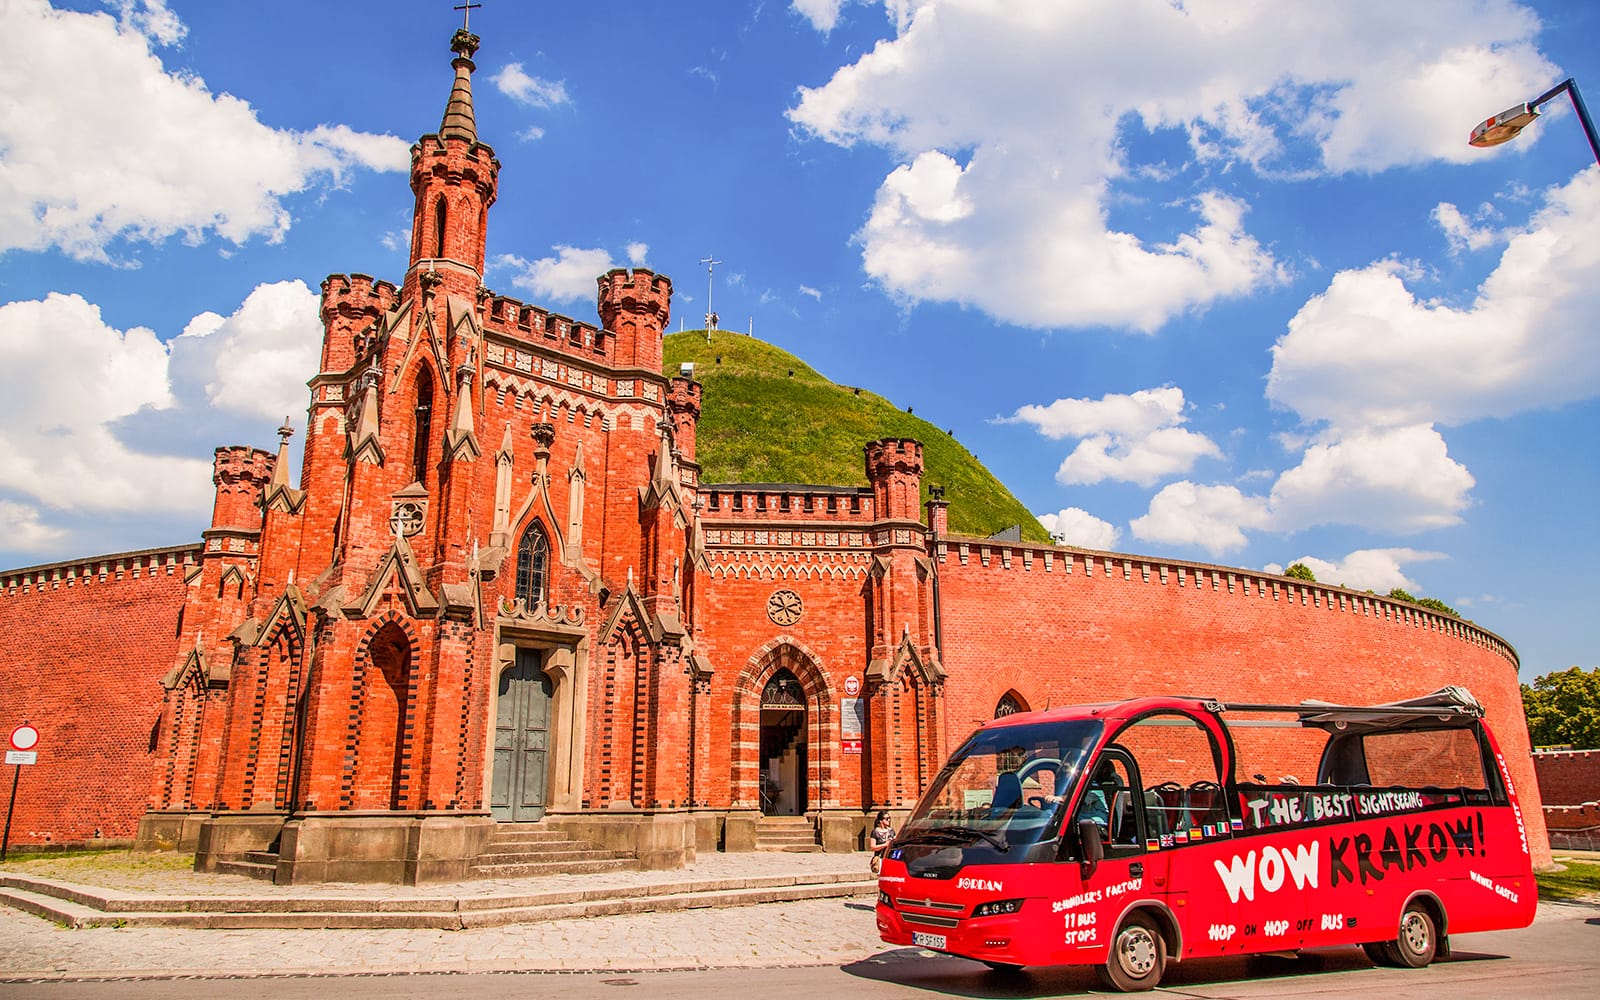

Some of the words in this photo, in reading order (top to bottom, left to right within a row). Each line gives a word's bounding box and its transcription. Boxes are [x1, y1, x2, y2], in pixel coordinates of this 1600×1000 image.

[1496, 753, 1515, 796] SQUARE
[1248, 797, 1302, 829] THE
[1311, 793, 1352, 821] BEST
[1359, 791, 1424, 815] SIGHTSEEING
[1511, 801, 1529, 854] MARKET
[1213, 840, 1319, 903] WOW
[1329, 811, 1486, 888] KRAKOW!
[956, 877, 1003, 891] JORDAN
[1051, 890, 1102, 913] SCHINDLER'S
[1105, 878, 1142, 898] FACTORY
[1469, 870, 1494, 890] WAWEL
[1495, 884, 1519, 904] CASTLE
[1064, 913, 1076, 928] 11
[1077, 912, 1096, 927] BUS
[1064, 928, 1096, 944] STOPS
[1207, 923, 1236, 941] HOP
[1244, 924, 1257, 935] ON
[1263, 920, 1289, 936] HOP
[1296, 918, 1314, 931] OFF
[1321, 913, 1343, 930] BUS
